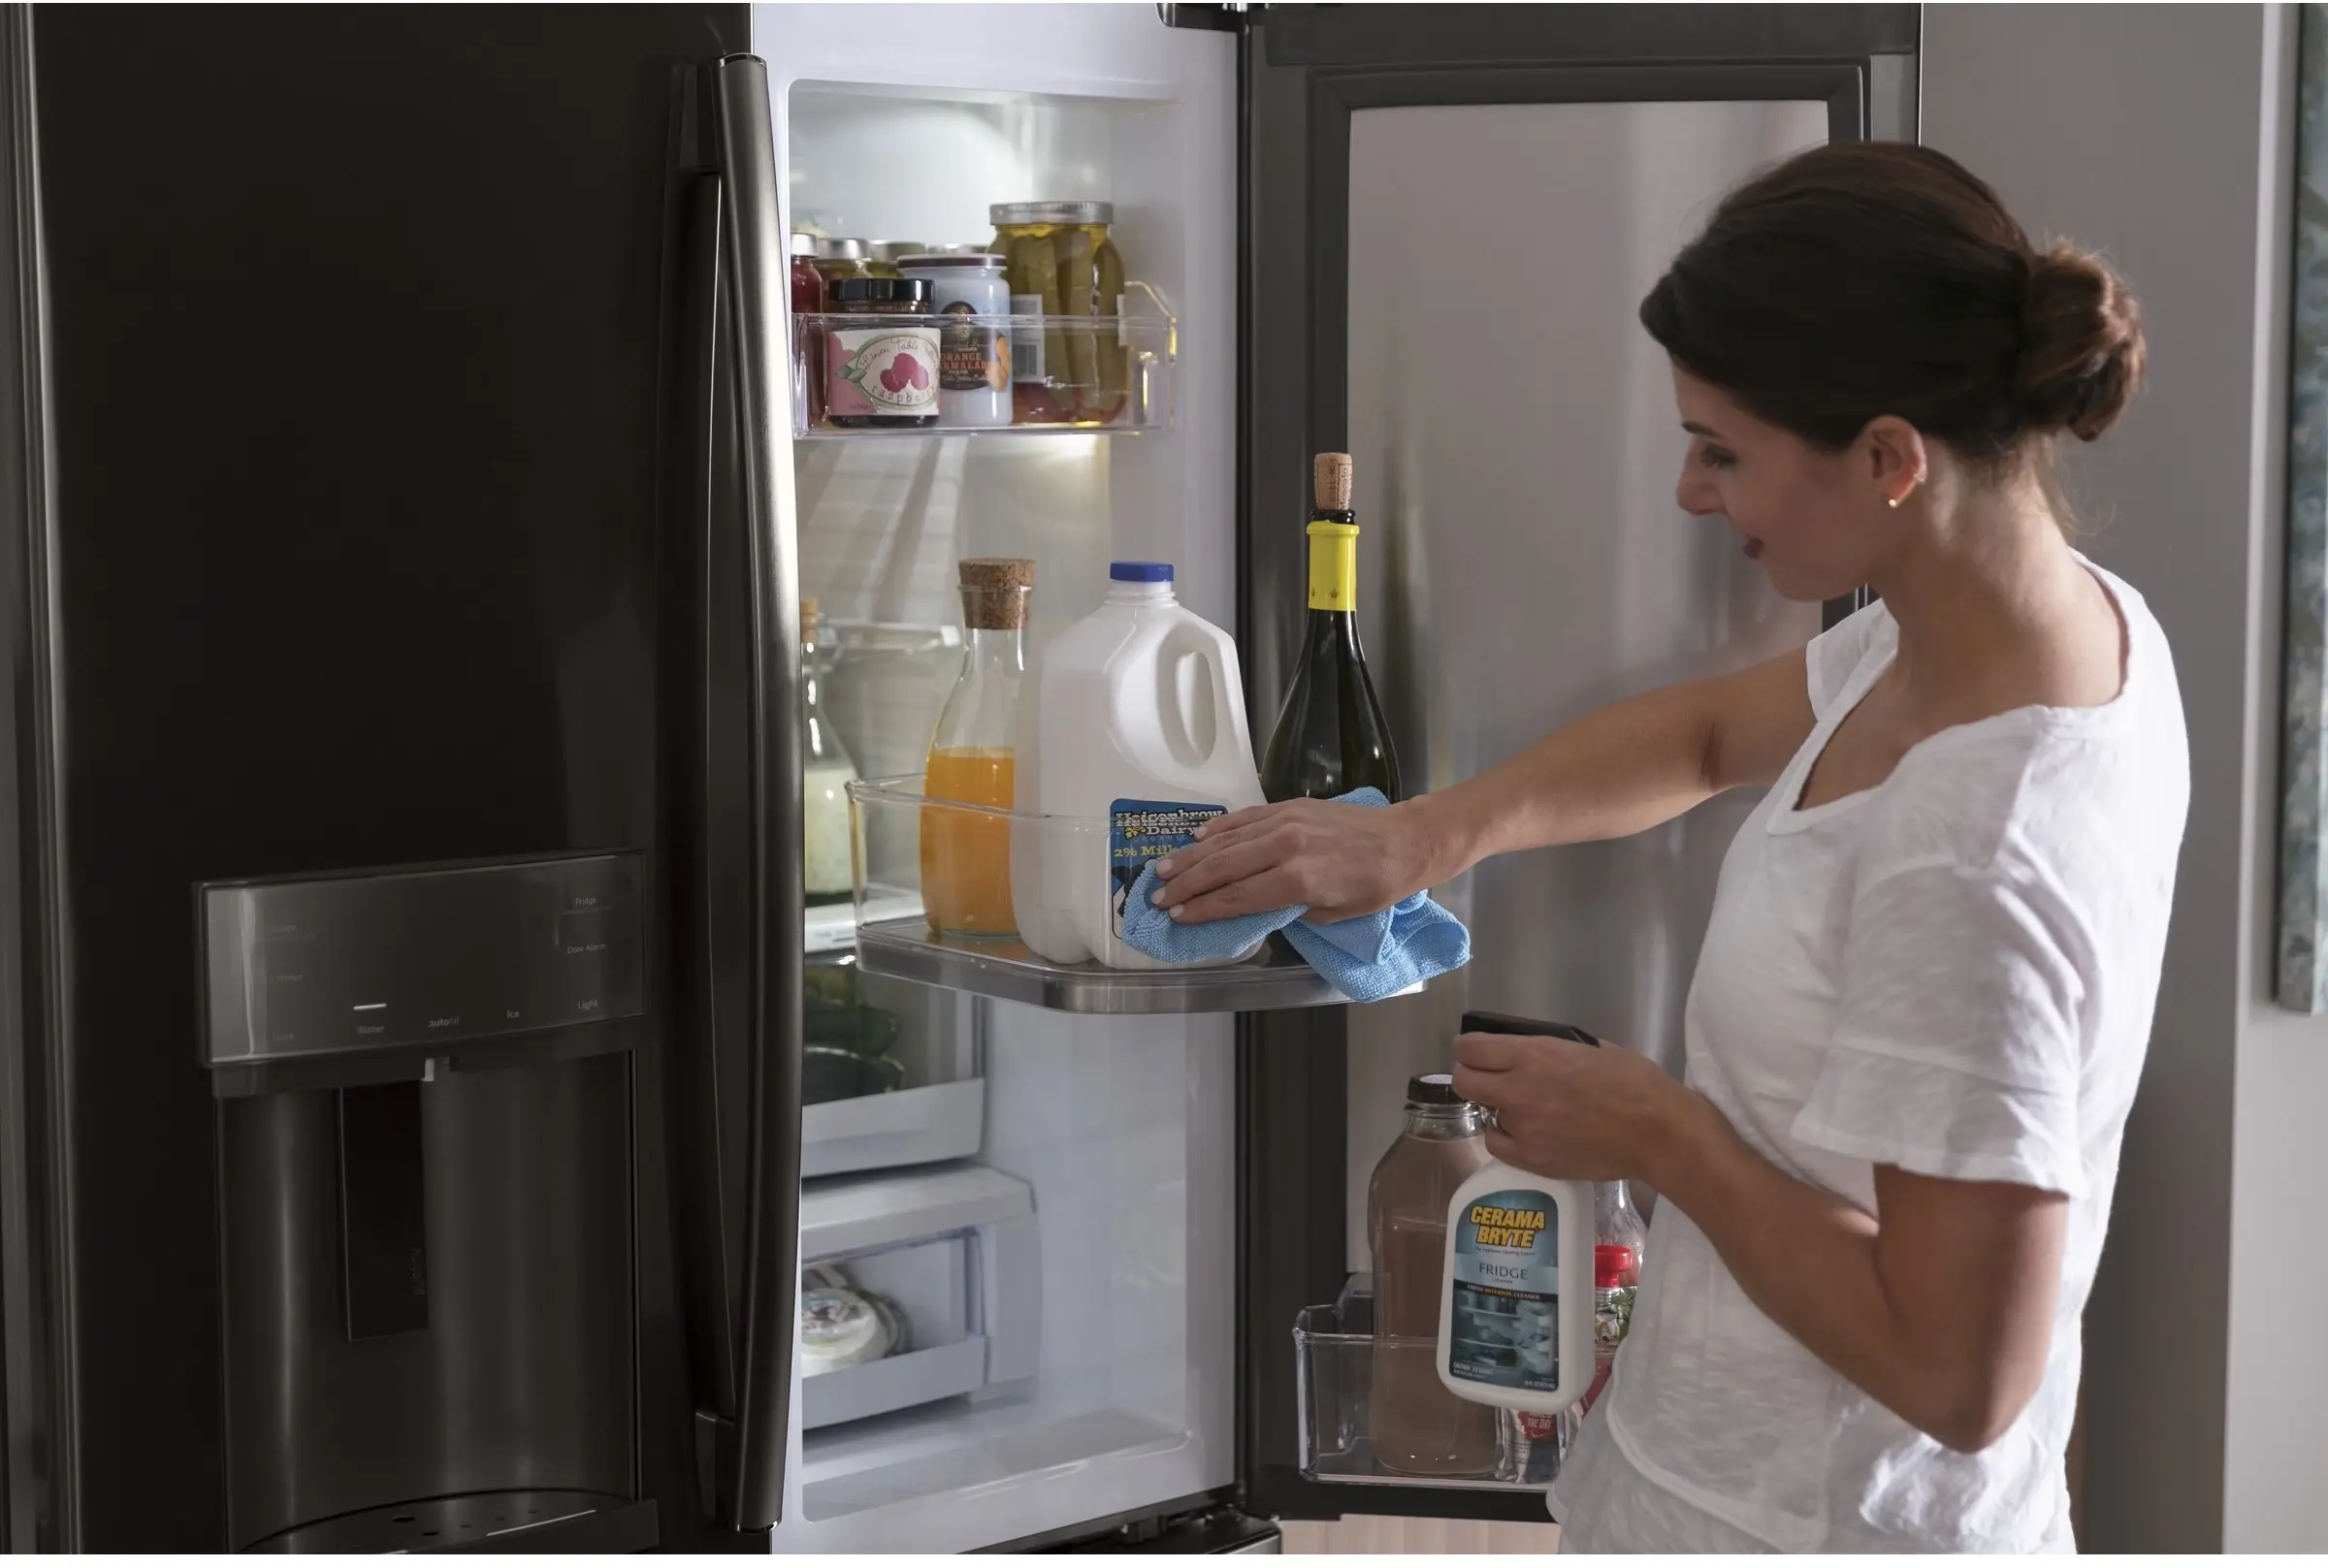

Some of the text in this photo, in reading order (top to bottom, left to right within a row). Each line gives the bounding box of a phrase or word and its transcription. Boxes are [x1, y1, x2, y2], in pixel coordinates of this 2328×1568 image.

[1147, 826, 1195, 836] Dairy
[1115, 848, 1138, 858] 2%
[574, 896, 598, 908] Fridge
[567, 943, 606, 954] Door Alarm
[577, 999, 598, 1011] Light
[506, 1009, 520, 1019] Ice
[357, 1023, 385, 1036] Water
[1470, 1205, 1546, 1231] CERAMA
[1475, 1225, 1536, 1250] BRYTE
[1479, 1262, 1529, 1280] FRIDGE
[1513, 1291, 1540, 1300] CLEANER
